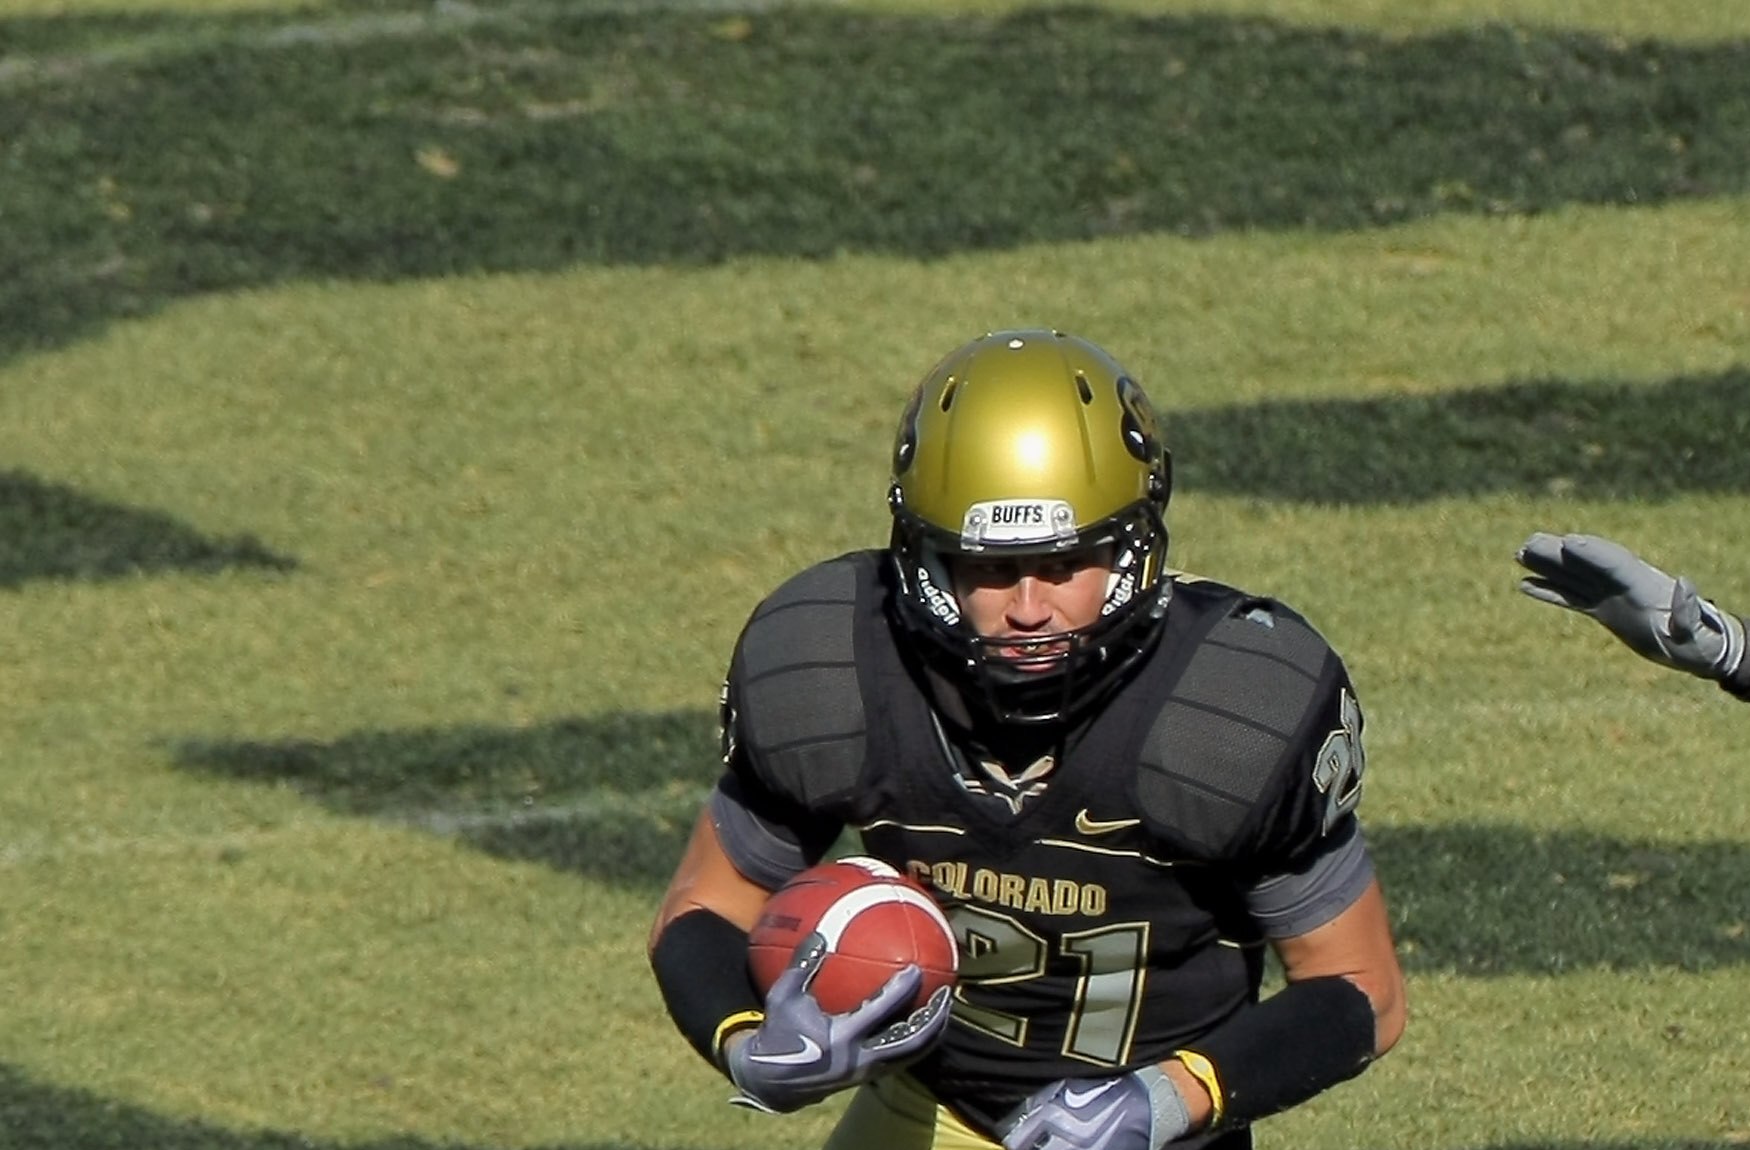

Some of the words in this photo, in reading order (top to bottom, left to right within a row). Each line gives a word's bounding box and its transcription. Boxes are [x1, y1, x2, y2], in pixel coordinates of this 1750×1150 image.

[992, 505, 1043, 523] BUFFS
[906, 859, 1107, 917] COLORADO
[949, 903, 1151, 1068] 21
